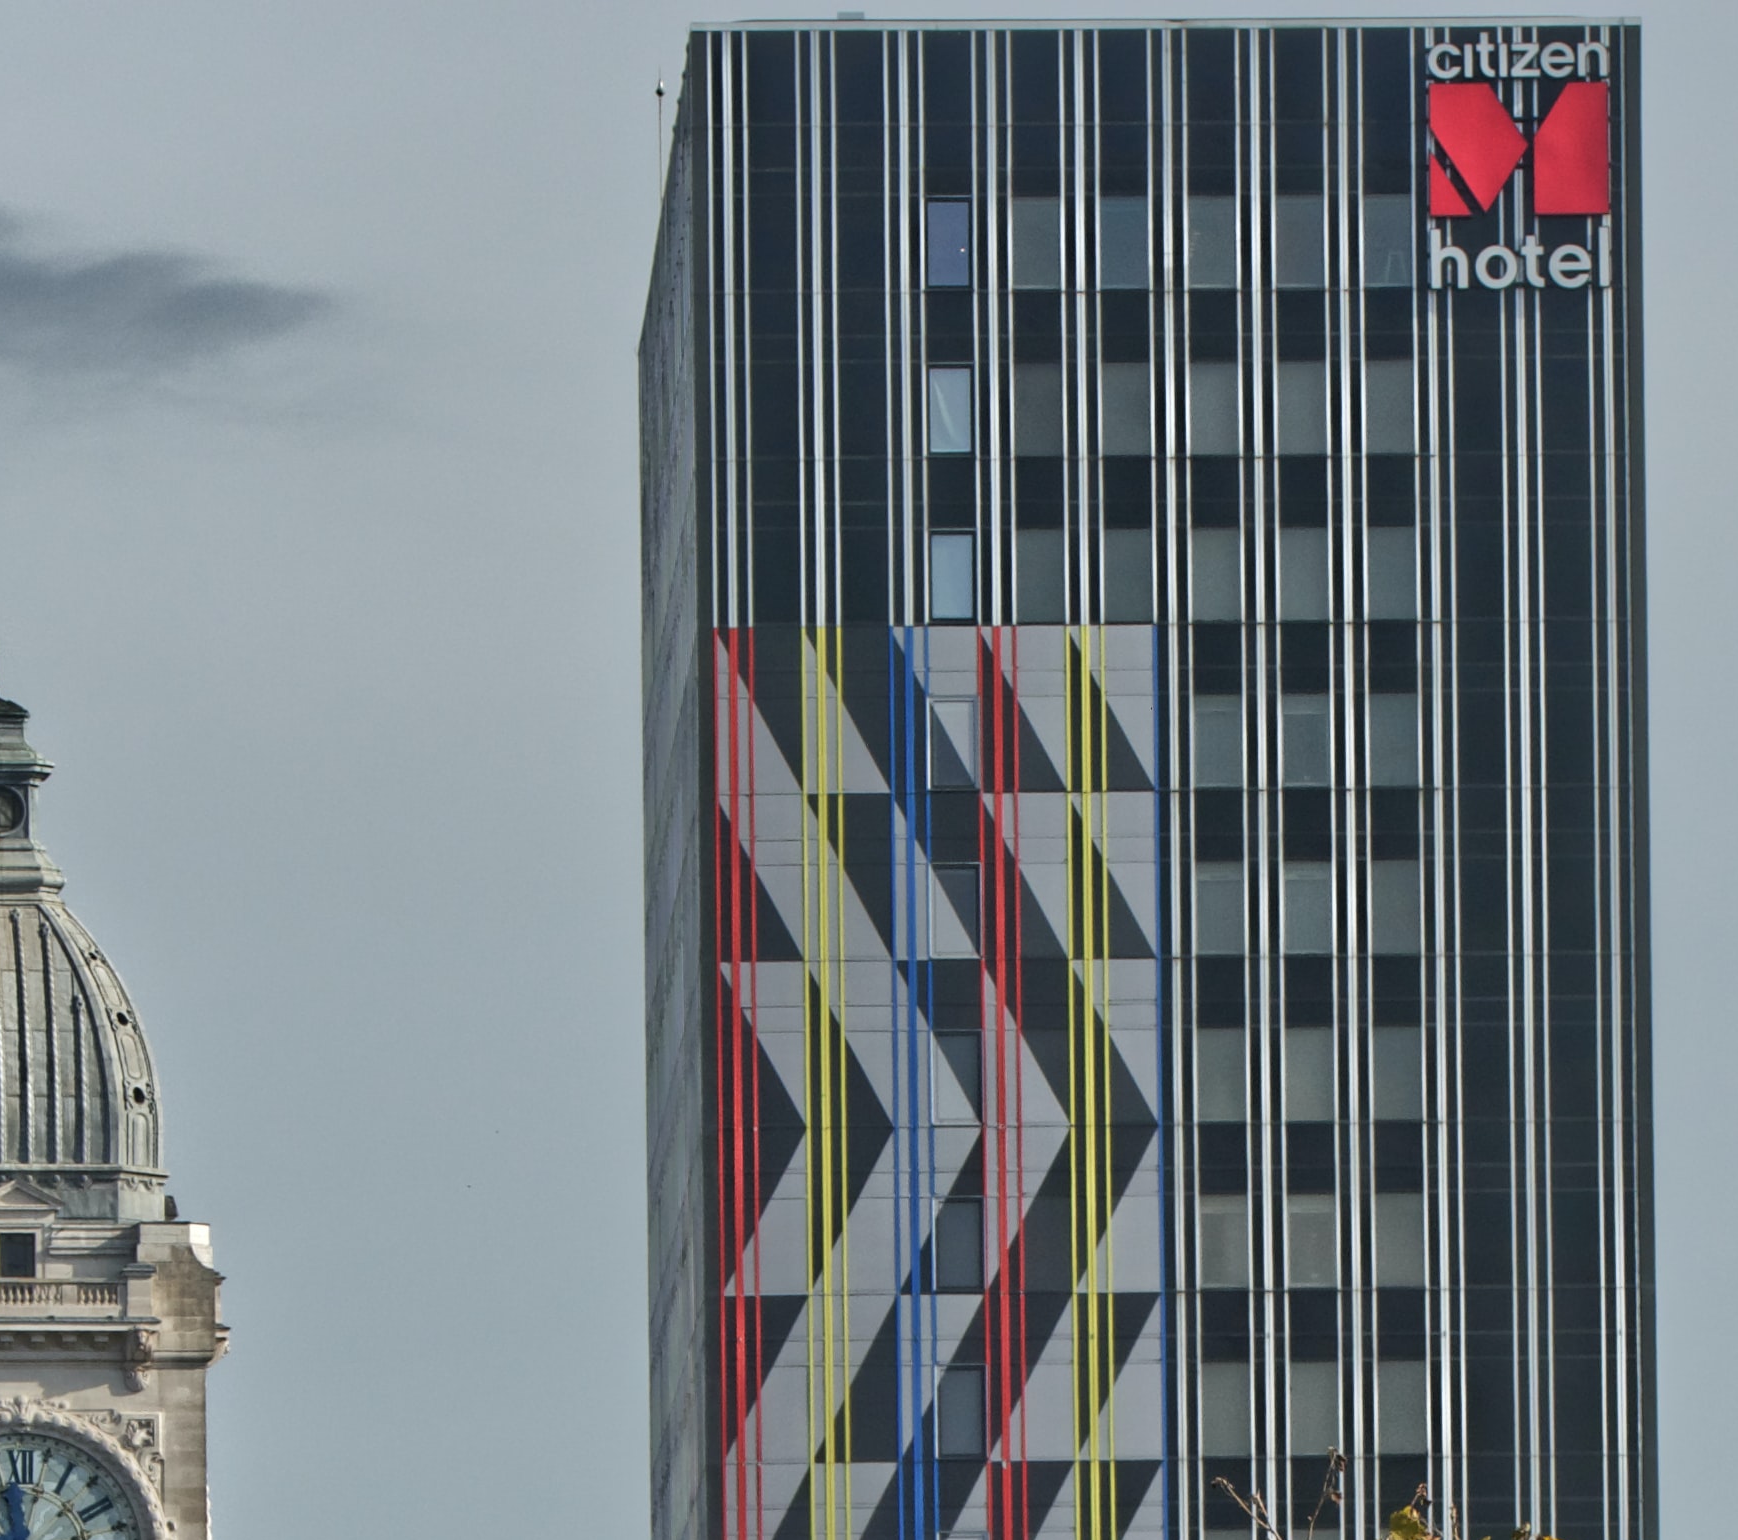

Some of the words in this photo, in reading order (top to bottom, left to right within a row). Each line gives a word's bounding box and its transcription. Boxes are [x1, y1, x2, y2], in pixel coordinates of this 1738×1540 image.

[1427, 31, 1609, 80] citizen
[1429, 226, 1611, 290] hotel
[9, 1450, 34, 1485] XII
